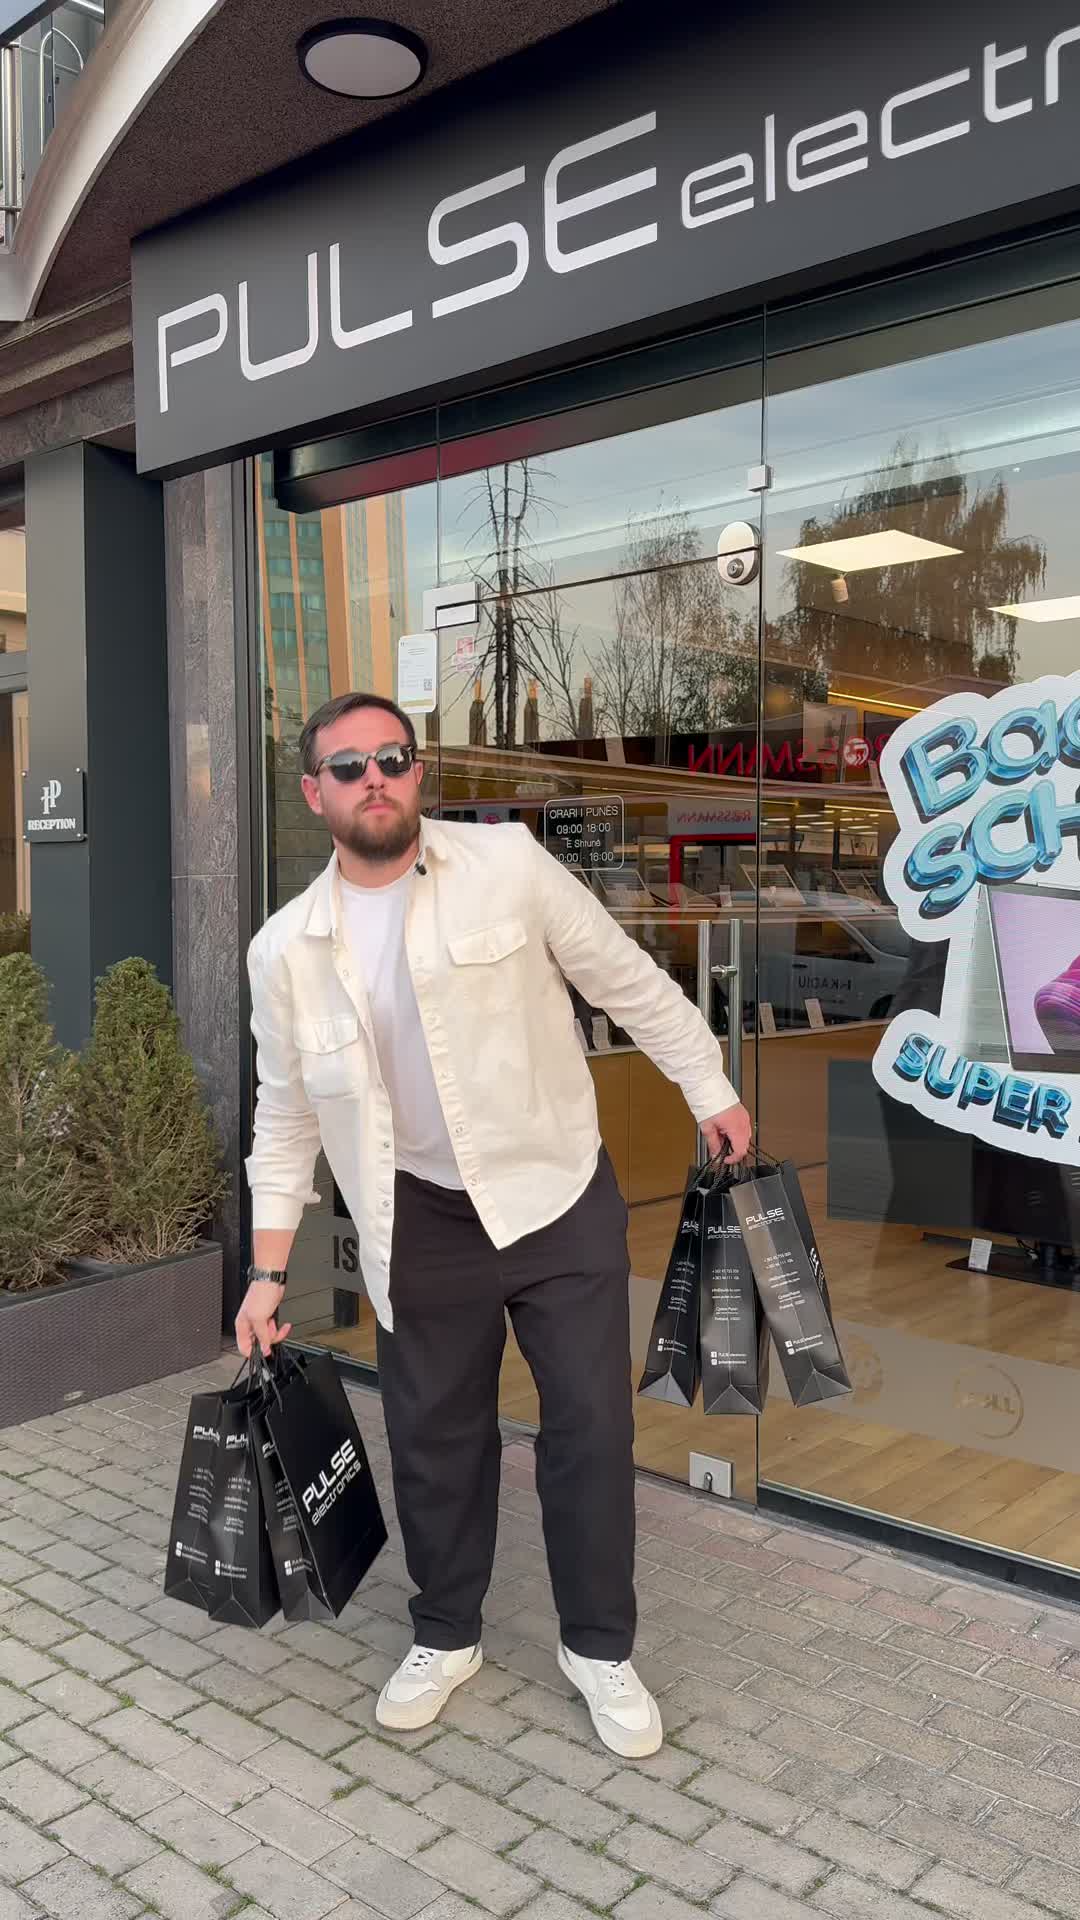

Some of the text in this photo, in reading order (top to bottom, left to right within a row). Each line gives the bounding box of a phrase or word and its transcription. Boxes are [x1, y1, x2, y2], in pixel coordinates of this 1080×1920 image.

[157, 111, 657, 413] PULSE
[27, 818, 76, 831] RECEPTION
[549, 808, 578, 819] ORARI
[892, 1032, 1072, 1140] SUPER
[707, 1225, 741, 1234] PULSE
[745, 1207, 784, 1225] PULSE
[302, 1438, 356, 1513] PULSE
[311, 1458, 362, 1526] electronics
